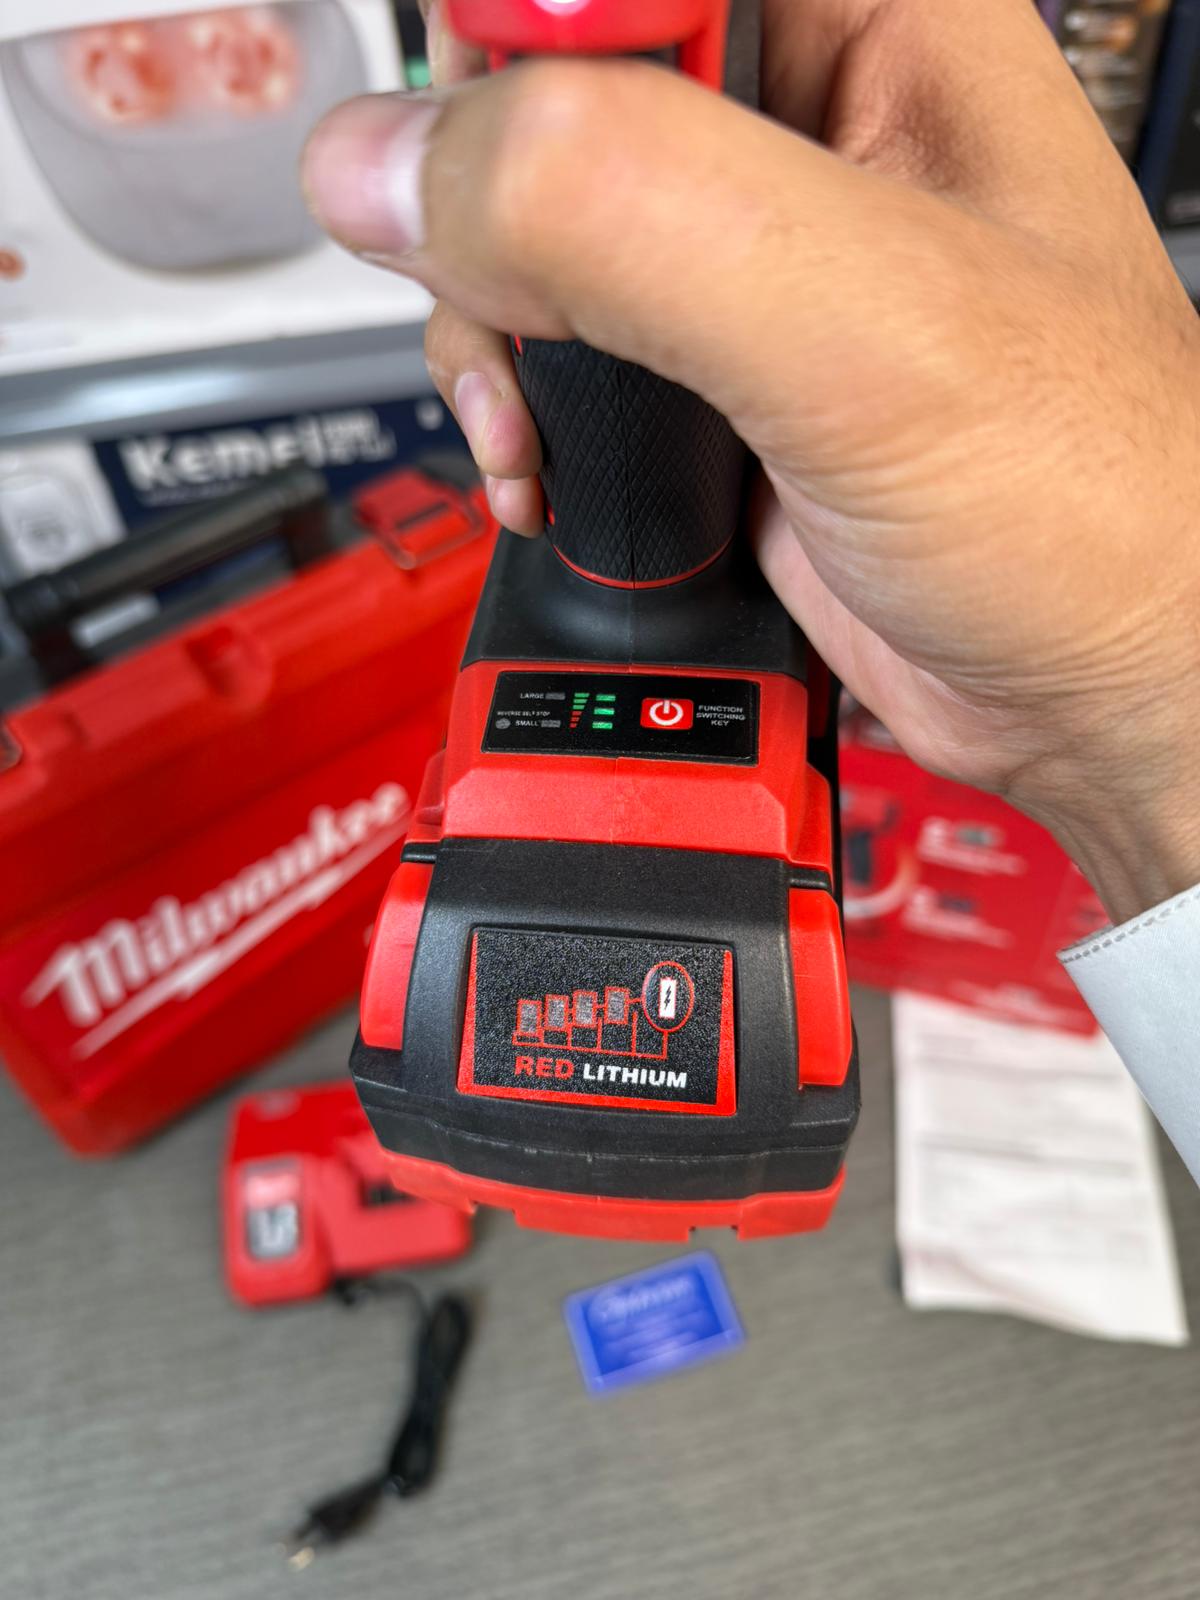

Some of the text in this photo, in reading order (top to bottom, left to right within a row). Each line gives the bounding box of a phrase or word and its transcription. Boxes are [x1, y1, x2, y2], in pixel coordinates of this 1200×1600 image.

[698, 704, 743, 713] FUNCTION
[696, 712, 746, 721] SWITCHING
[514, 1055, 688, 1089] RED LITHIUM
